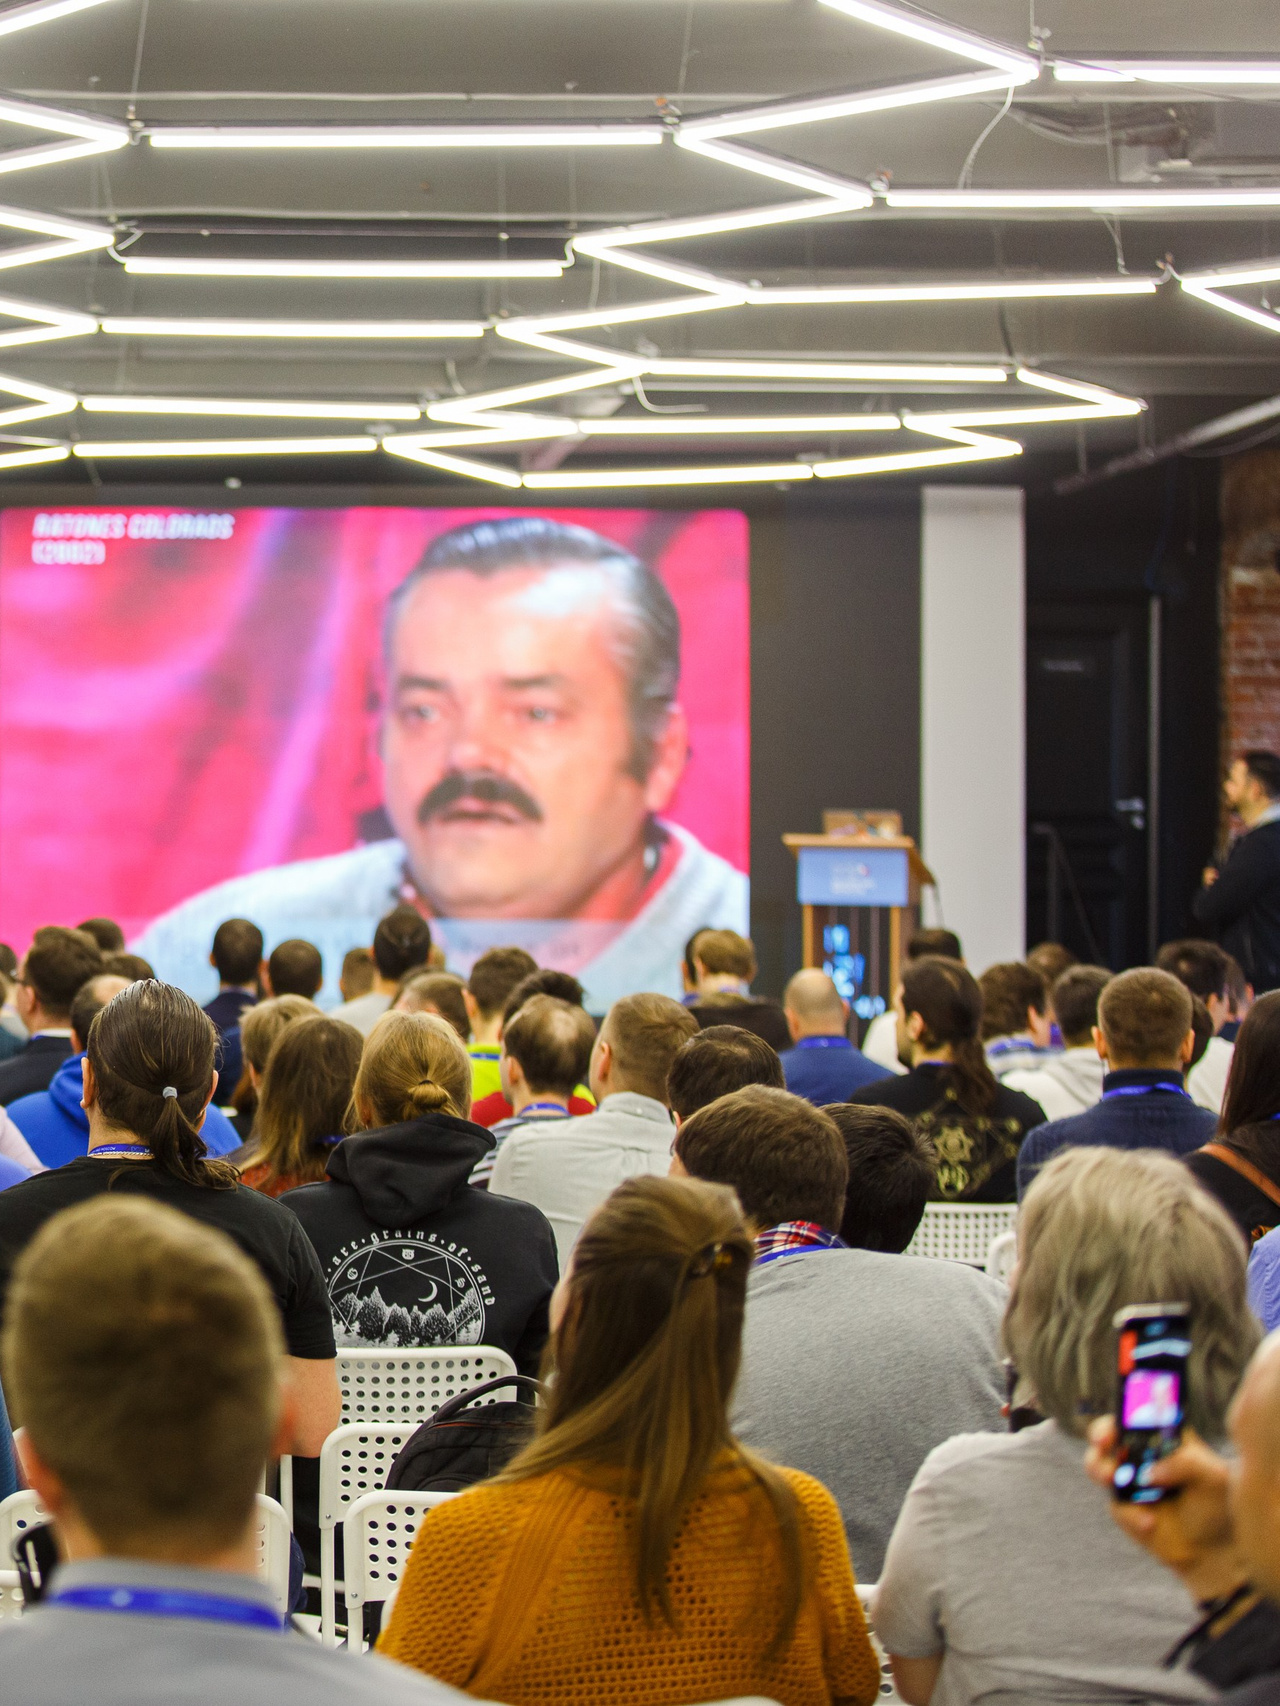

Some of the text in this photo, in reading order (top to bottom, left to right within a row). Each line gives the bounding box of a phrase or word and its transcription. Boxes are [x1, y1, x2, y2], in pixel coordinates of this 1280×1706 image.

[332, 1230, 496, 1306] are grains of sand
